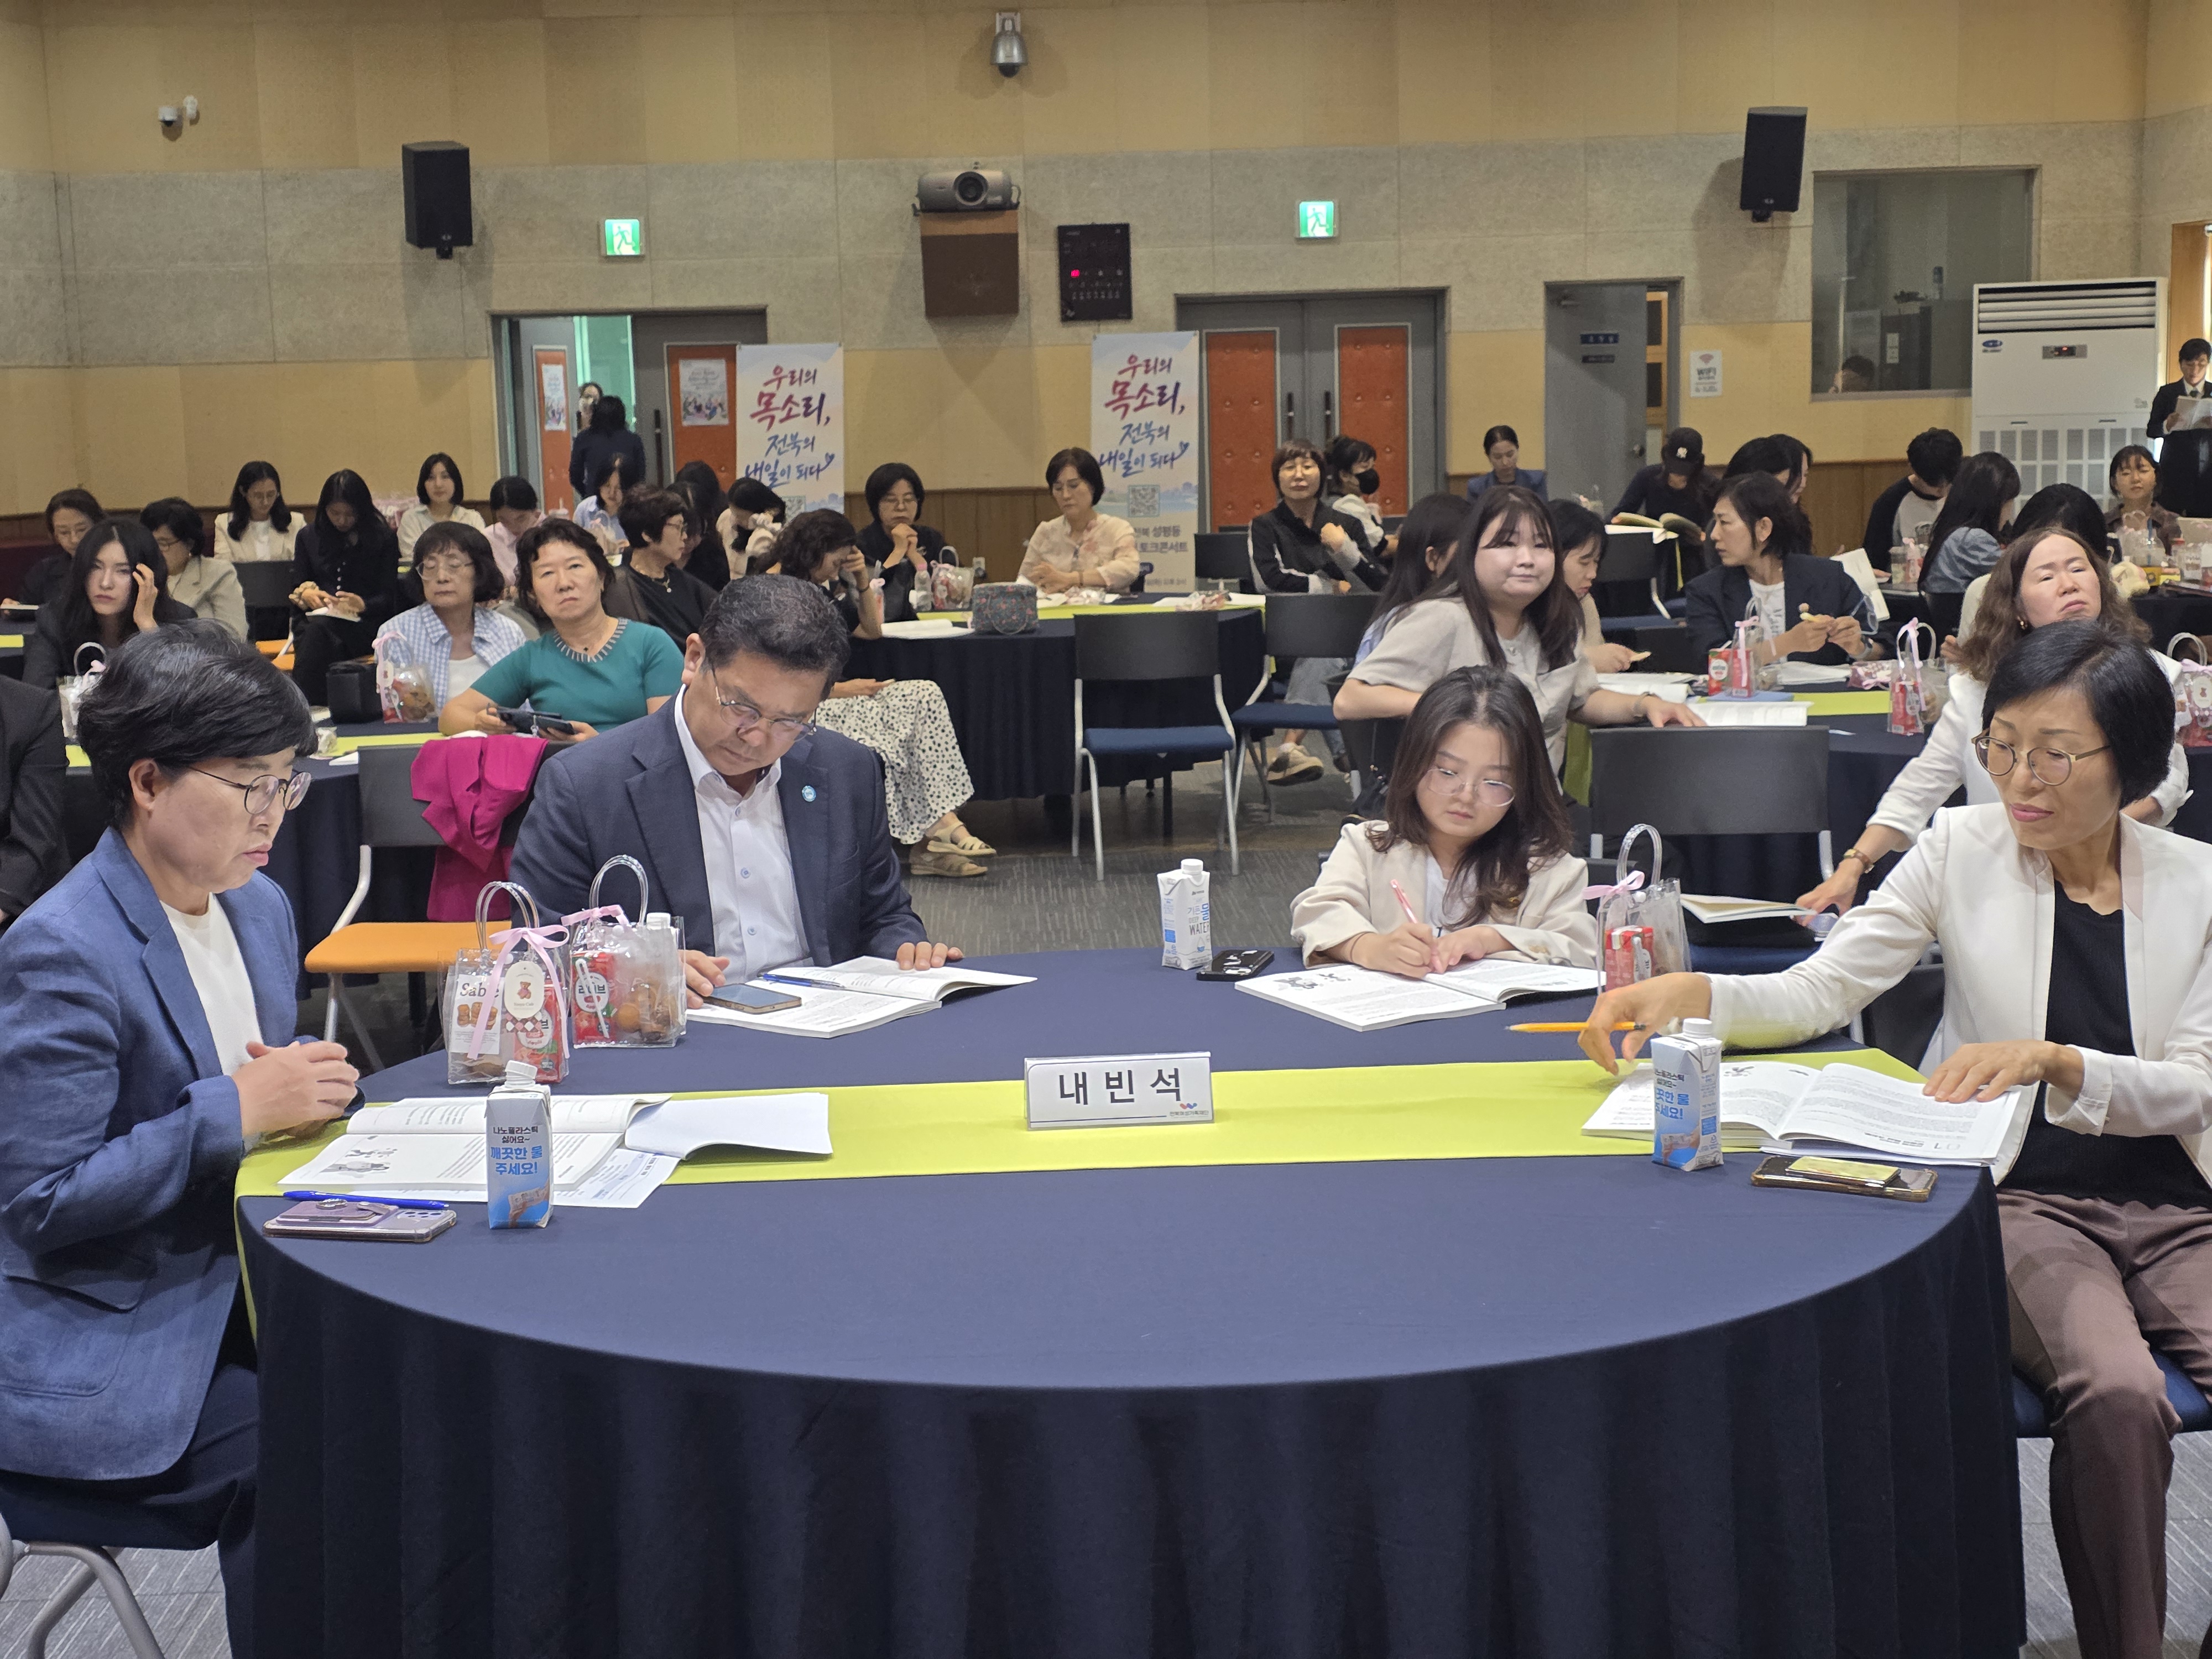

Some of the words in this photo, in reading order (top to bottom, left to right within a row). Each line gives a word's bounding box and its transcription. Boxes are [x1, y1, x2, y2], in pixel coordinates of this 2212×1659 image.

[763, 365, 817, 390] 우리의
[1118, 354, 1172, 378] 우리의
[750, 390, 830, 432] 목소리,
[1105, 380, 1185, 420] 목소리,
[765, 432, 815, 457] 전북의
[1119, 421, 1170, 446] 전북의
[745, 459, 791, 489] 내일이
[1099, 448, 1145, 478] 내일이
[1677, 1093, 1689, 1105] 물
[493, 1126, 538, 1134] 나노플라스틱
[491, 1146, 528, 1160] 깨끗한
[531, 1145, 542, 1159] 물
[495, 1161, 538, 1175] 주세요!
